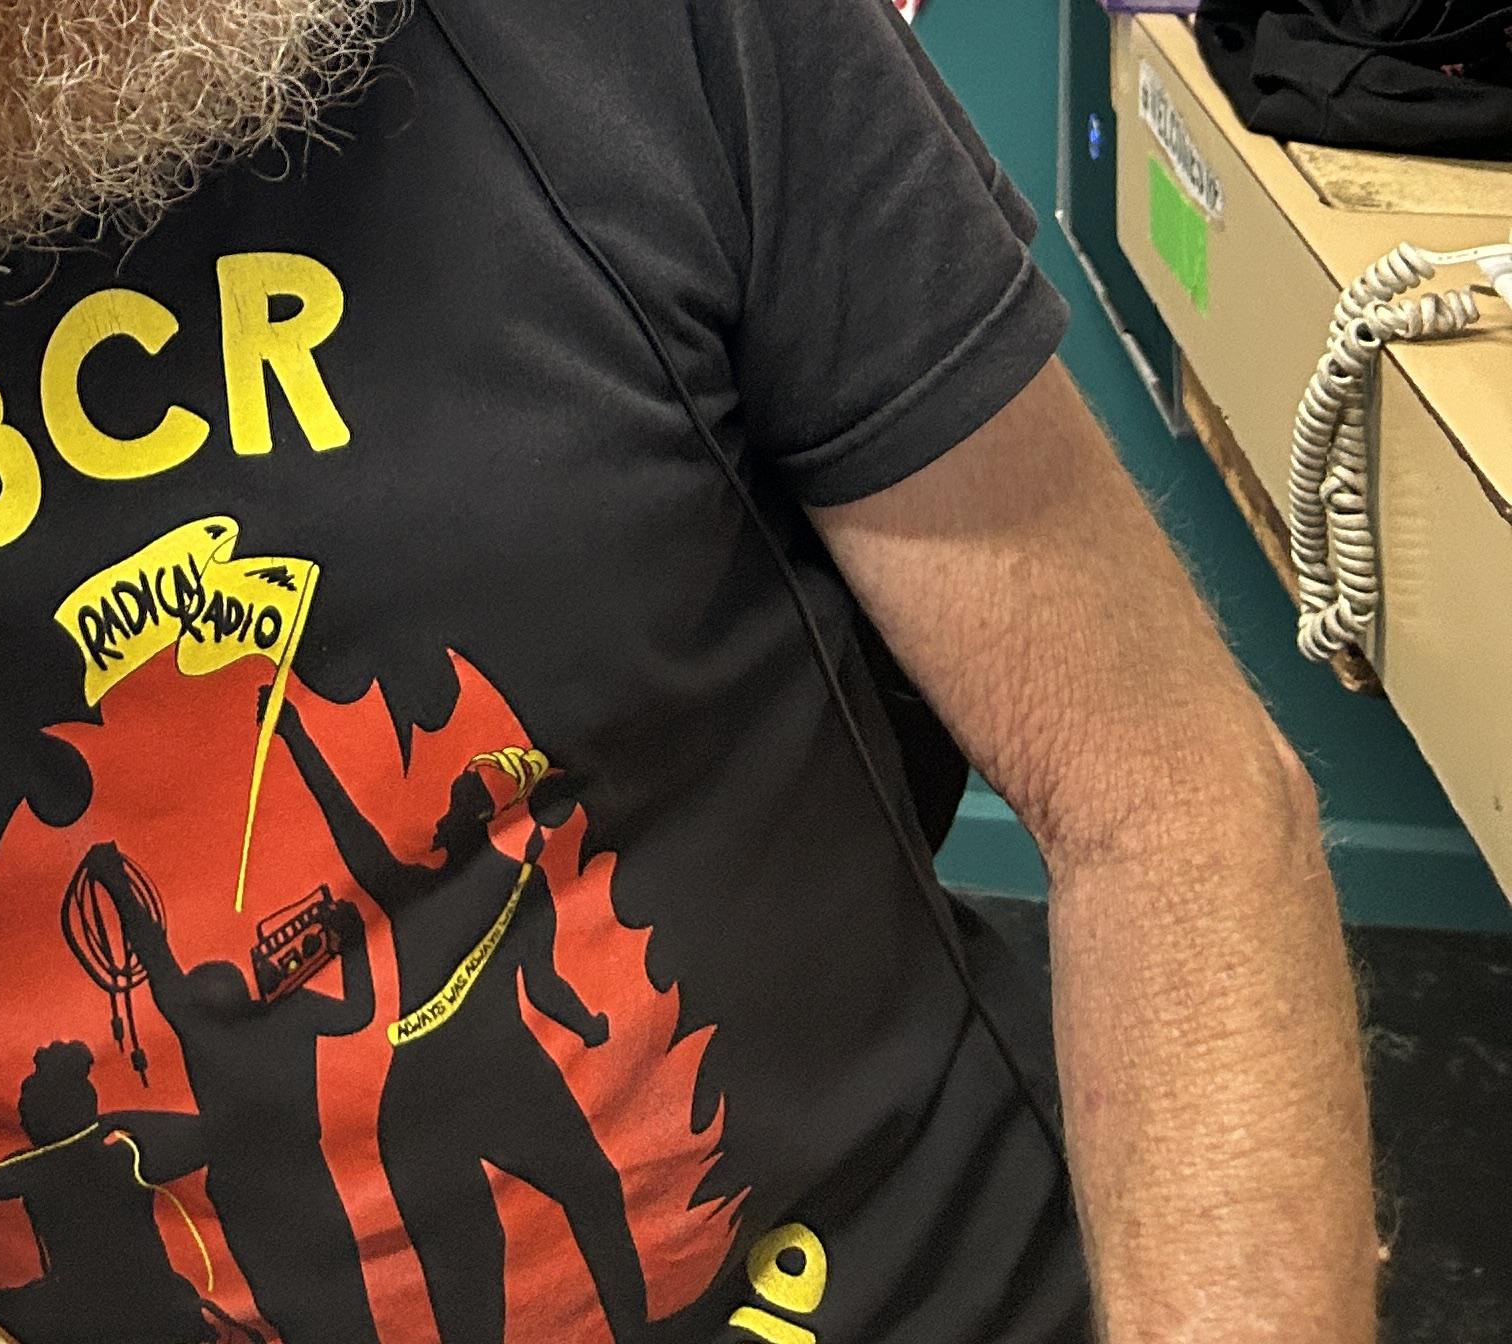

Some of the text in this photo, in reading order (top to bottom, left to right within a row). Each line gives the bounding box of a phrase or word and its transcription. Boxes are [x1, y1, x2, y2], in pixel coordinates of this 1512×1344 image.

[78, 552, 202, 671] RADICAL
[397, 927, 501, 1040] ALWAYS WAS ALWAYS
